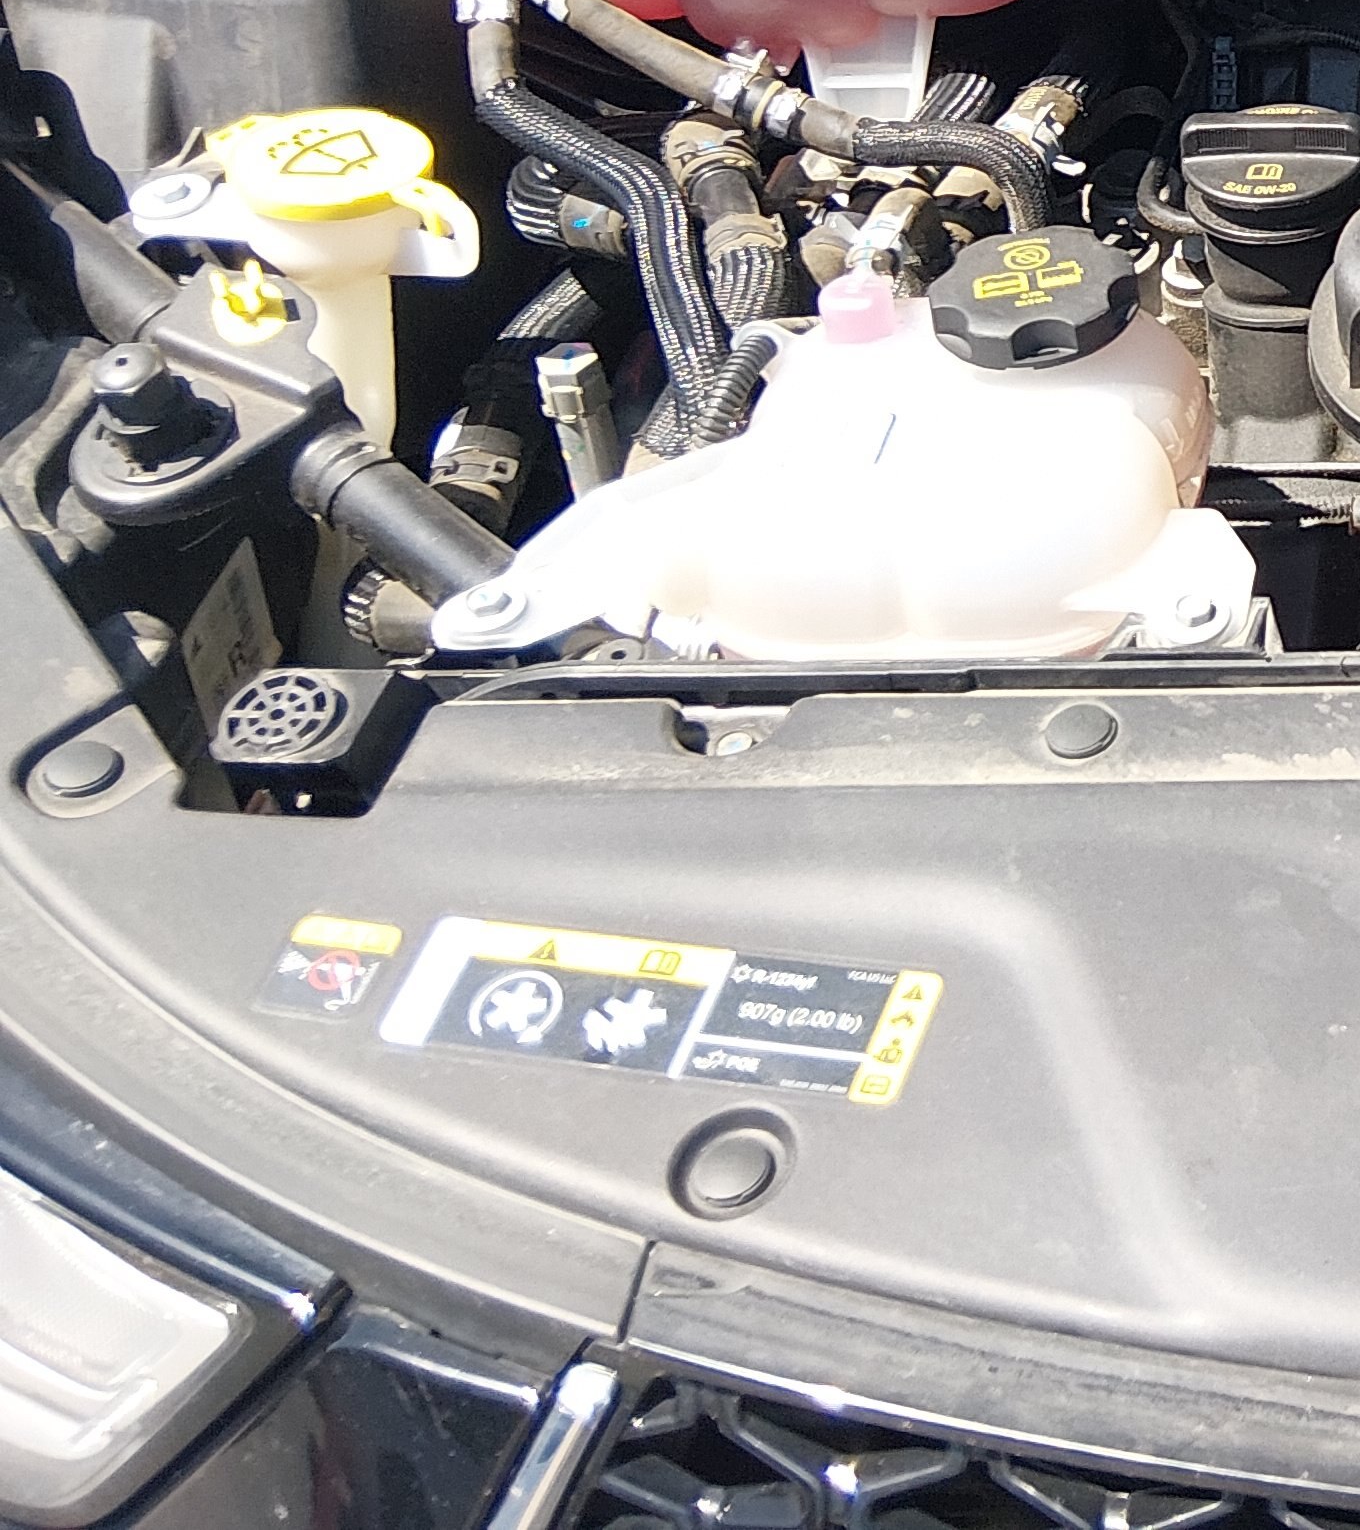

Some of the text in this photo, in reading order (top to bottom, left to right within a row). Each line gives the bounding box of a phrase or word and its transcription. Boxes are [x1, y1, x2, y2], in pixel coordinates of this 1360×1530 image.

[1222, 181, 1297, 195] SAE 0W-20
[740, 1002, 786, 1025] 907g
[836, 1013, 863, 1034] lb)
